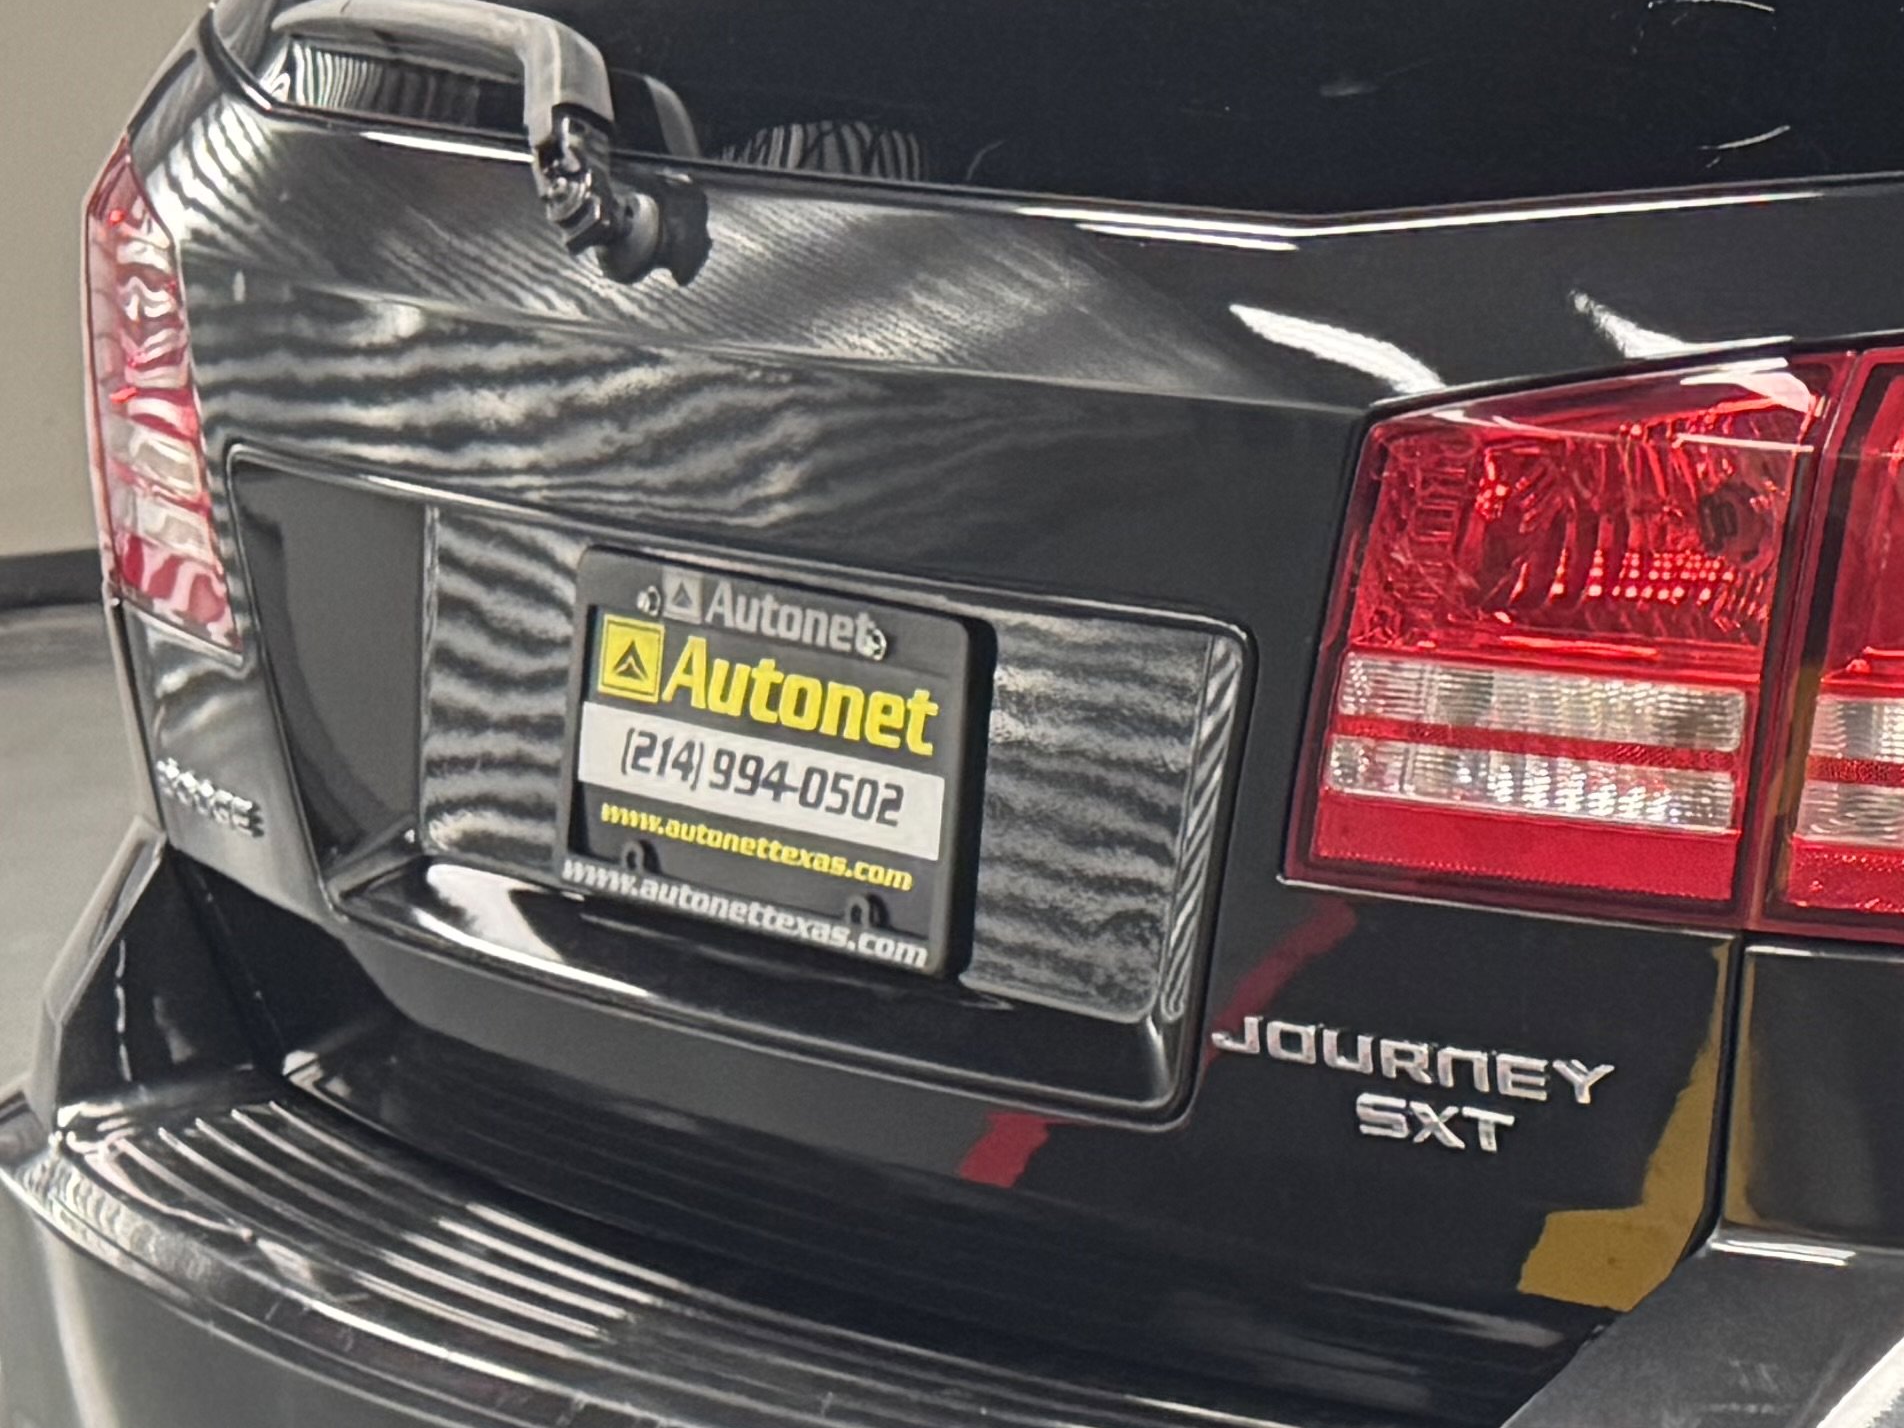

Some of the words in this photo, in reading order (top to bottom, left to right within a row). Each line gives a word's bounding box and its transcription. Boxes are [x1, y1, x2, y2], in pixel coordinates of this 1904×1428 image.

[704, 580, 876, 655] Autonet
[662, 636, 939, 756] Autonet
[621, 726, 705, 791] (214)
[708, 753, 904, 828] 994-0502
[600, 802, 913, 892] www.autonettexas.com
[562, 858, 928, 967] www.autonettexas.com
[1211, 1015, 1615, 1104] JOURNEY
[1356, 1092, 1515, 1153] SXT
